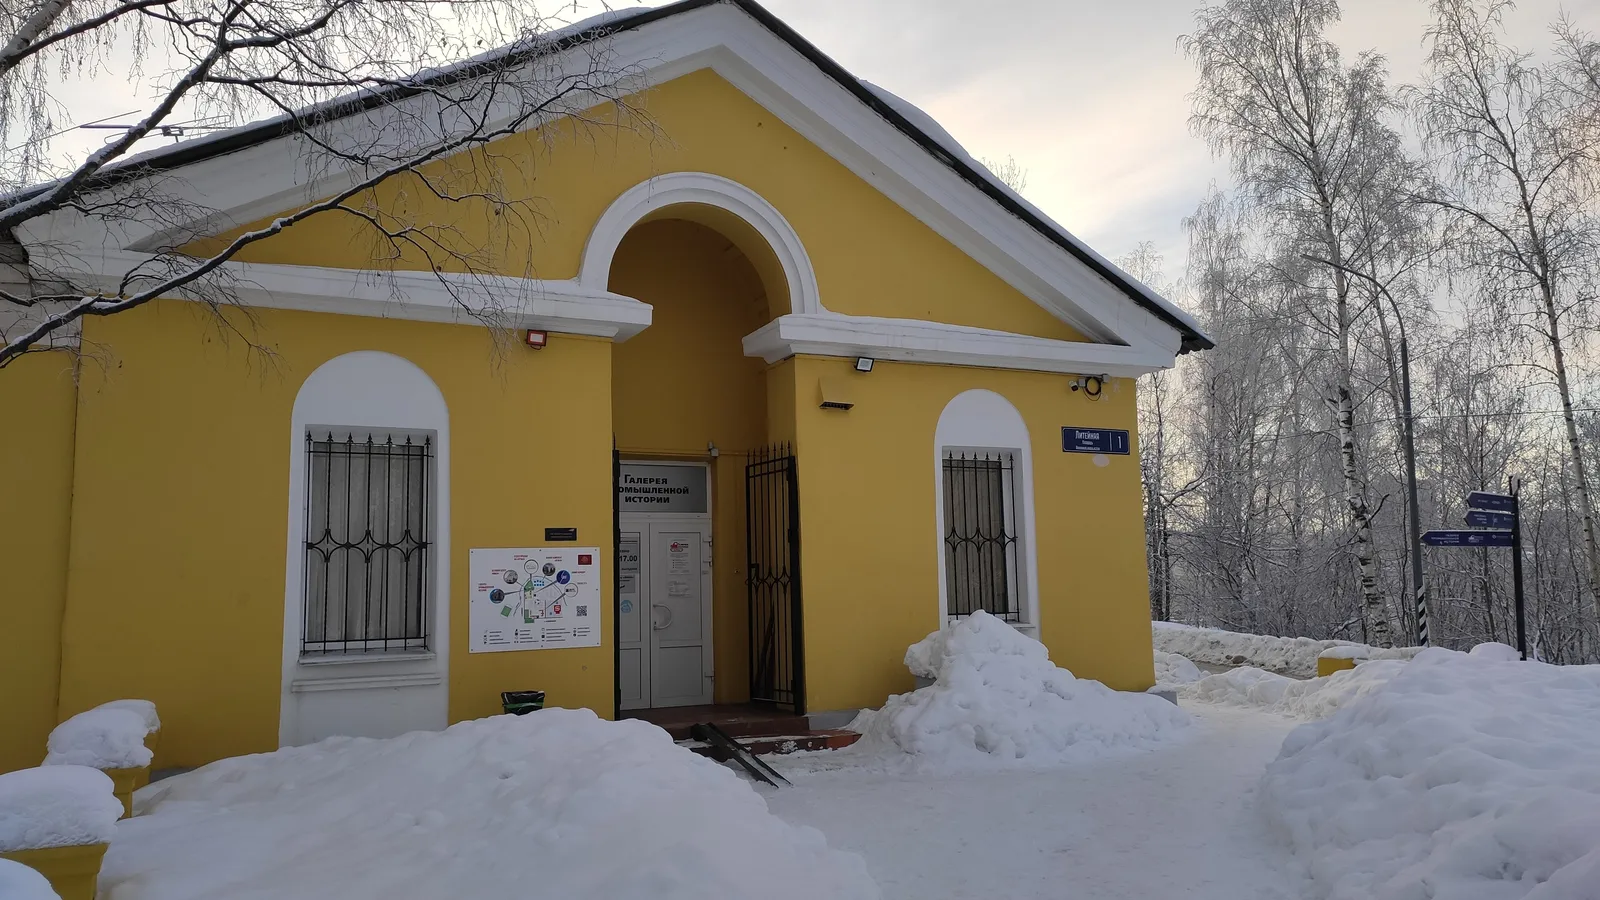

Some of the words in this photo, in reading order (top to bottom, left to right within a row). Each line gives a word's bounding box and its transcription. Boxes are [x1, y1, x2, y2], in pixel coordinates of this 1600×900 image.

[1117, 435, 1122, 449] 1
[624, 474, 668, 485] ГАЛЕРЕЯ
[619, 486, 689, 495] ОМЫШЛЕННОЙ
[624, 496, 670, 504] ИСТОРИИ
